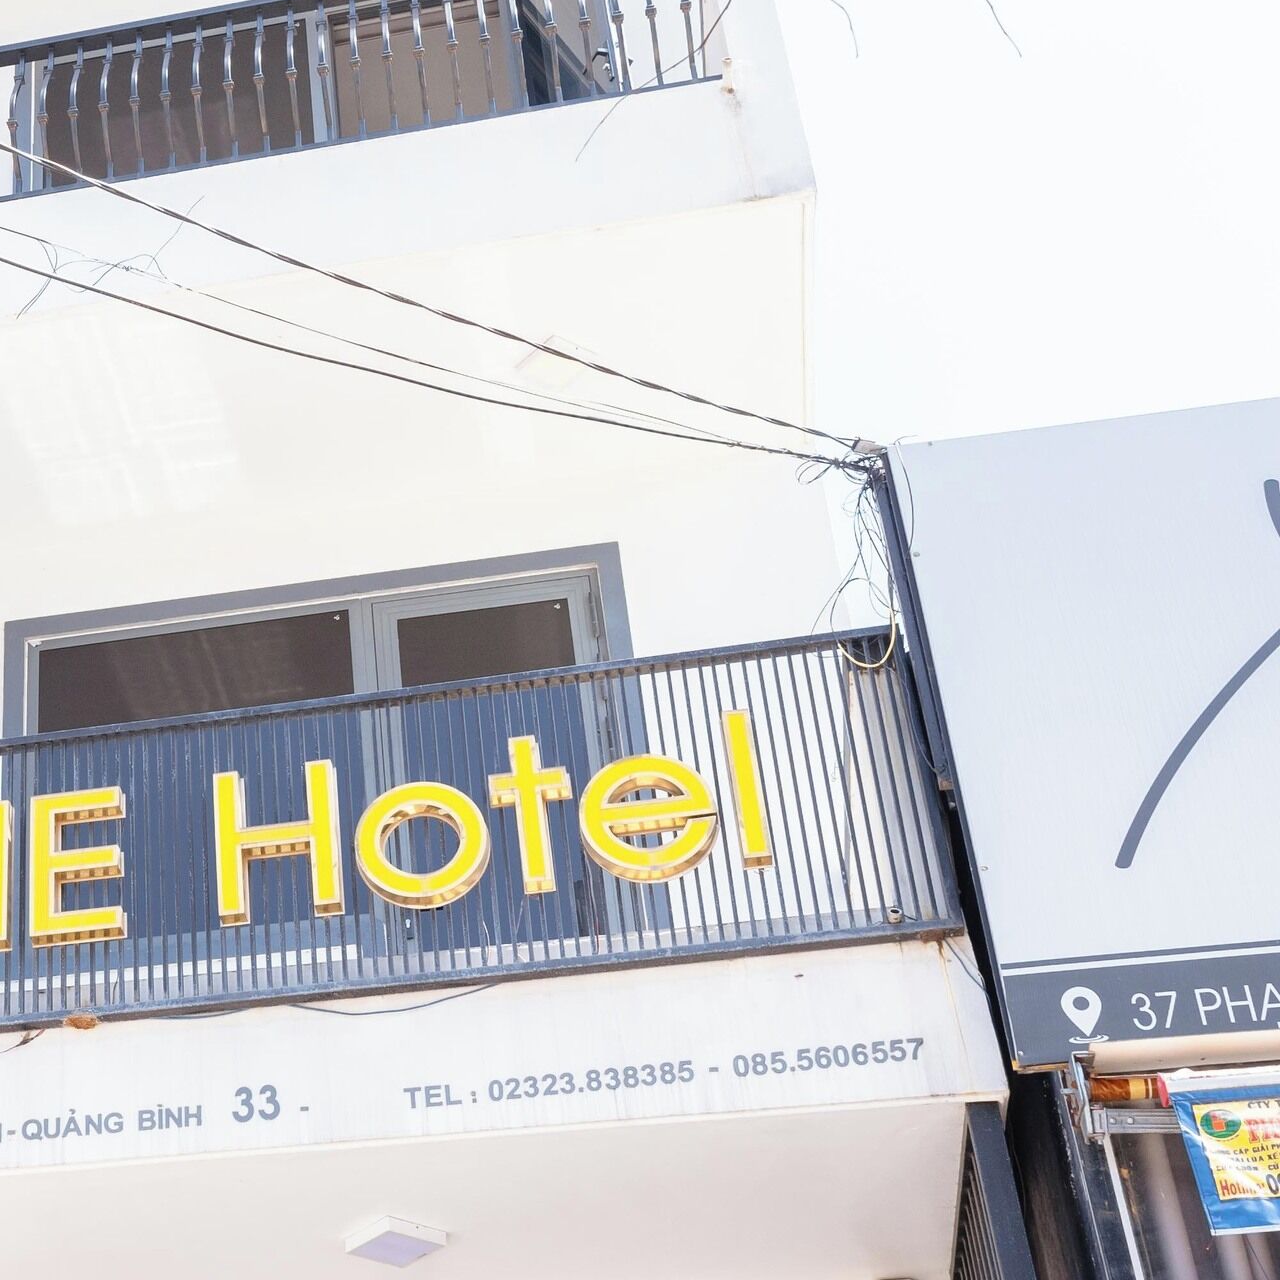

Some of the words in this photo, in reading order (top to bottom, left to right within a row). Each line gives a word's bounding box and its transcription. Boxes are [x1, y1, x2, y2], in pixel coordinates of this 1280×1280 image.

[213, 708, 773, 927] Hotel
[1131, 990, 1177, 1031] 37
[488, 1059, 695, 1102] 02323.838385
[732, 1037, 925, 1078] 085.5606557
[137, 1103, 203, 1132] BÌNH
[232, 1084, 281, 1123] 33
